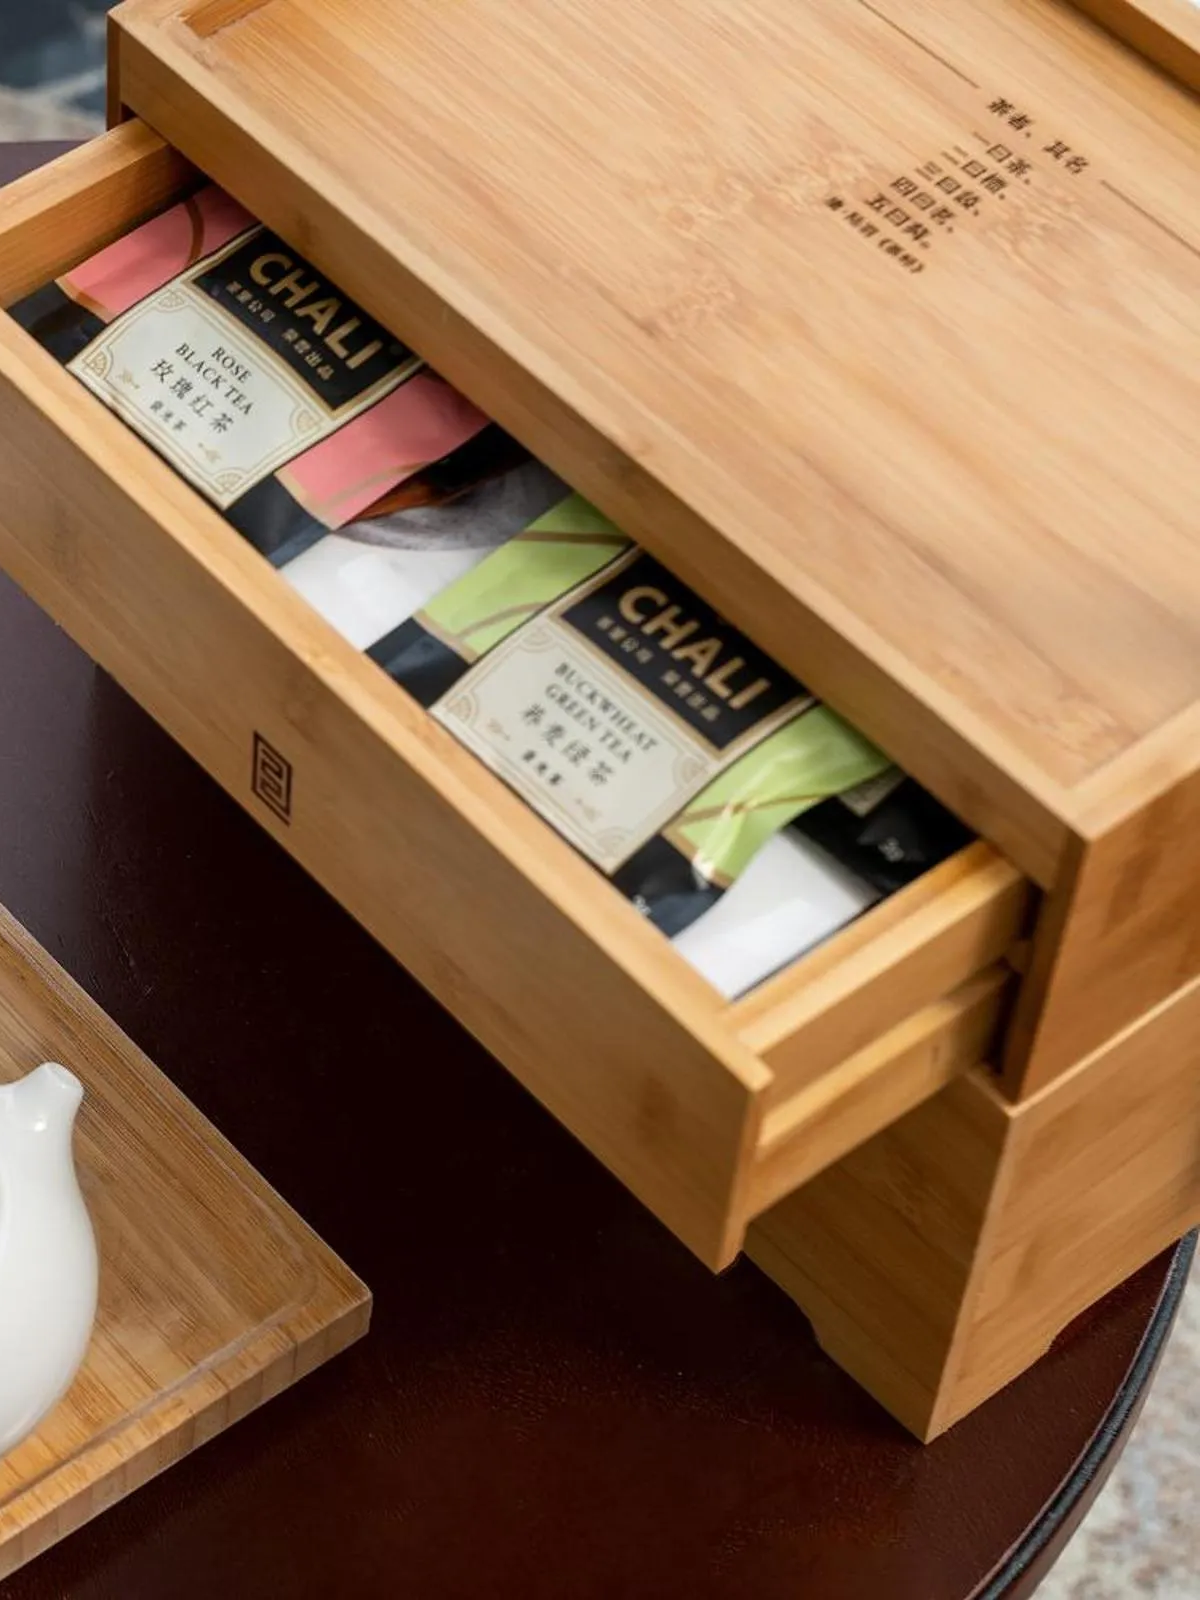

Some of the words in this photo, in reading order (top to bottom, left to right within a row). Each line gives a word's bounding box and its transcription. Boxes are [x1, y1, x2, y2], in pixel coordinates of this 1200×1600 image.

[249, 252, 383, 369] CHALI
[151, 359, 234, 433] 玫瑰红茶
[175, 343, 227, 389] BLACK
[224, 385, 254, 415] TEA
[211, 346, 252, 383] ROSE
[619, 586, 771, 709] CHALI
[545, 683, 599, 731] GREEN
[599, 729, 631, 764] TEA
[555, 662, 658, 750] BUCKWHEAT
